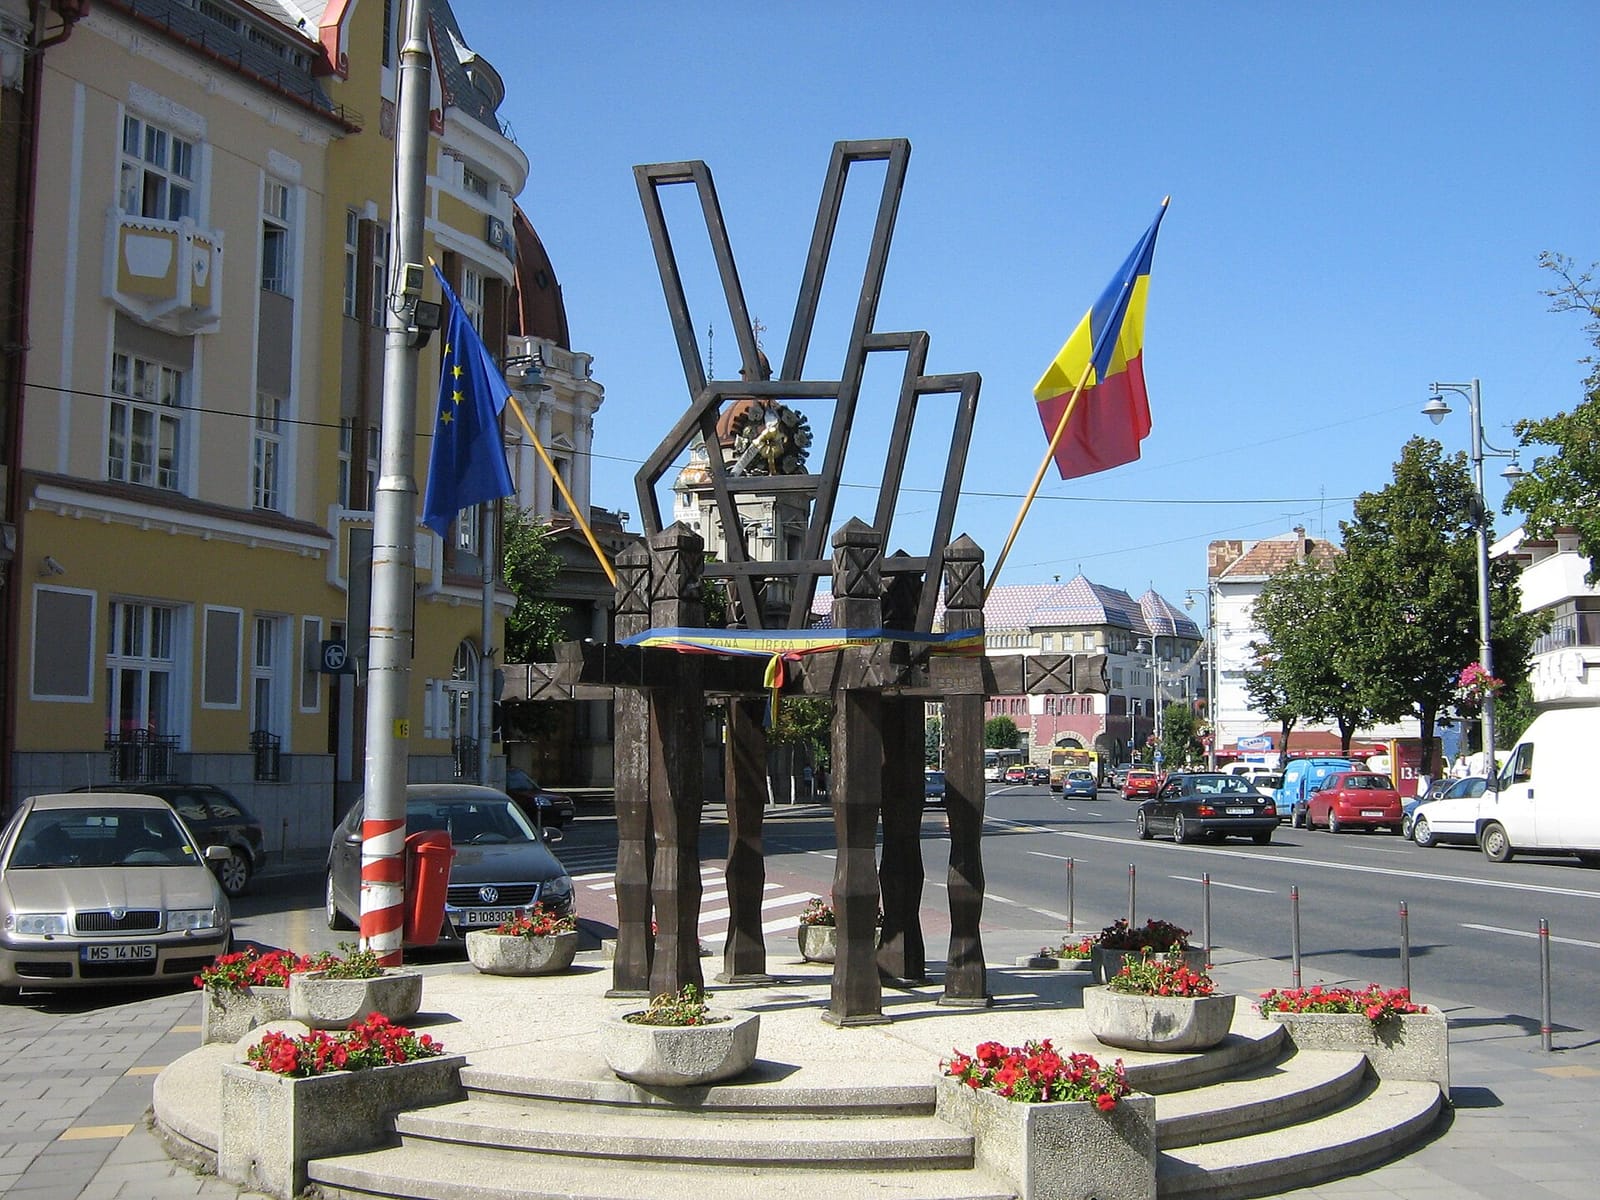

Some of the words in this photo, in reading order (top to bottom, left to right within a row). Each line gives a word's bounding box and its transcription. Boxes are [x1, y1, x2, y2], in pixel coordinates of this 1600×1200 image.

[90, 947, 109, 959] MS
[115, 946, 126, 958] 14
[130, 945, 152, 957] NIS
